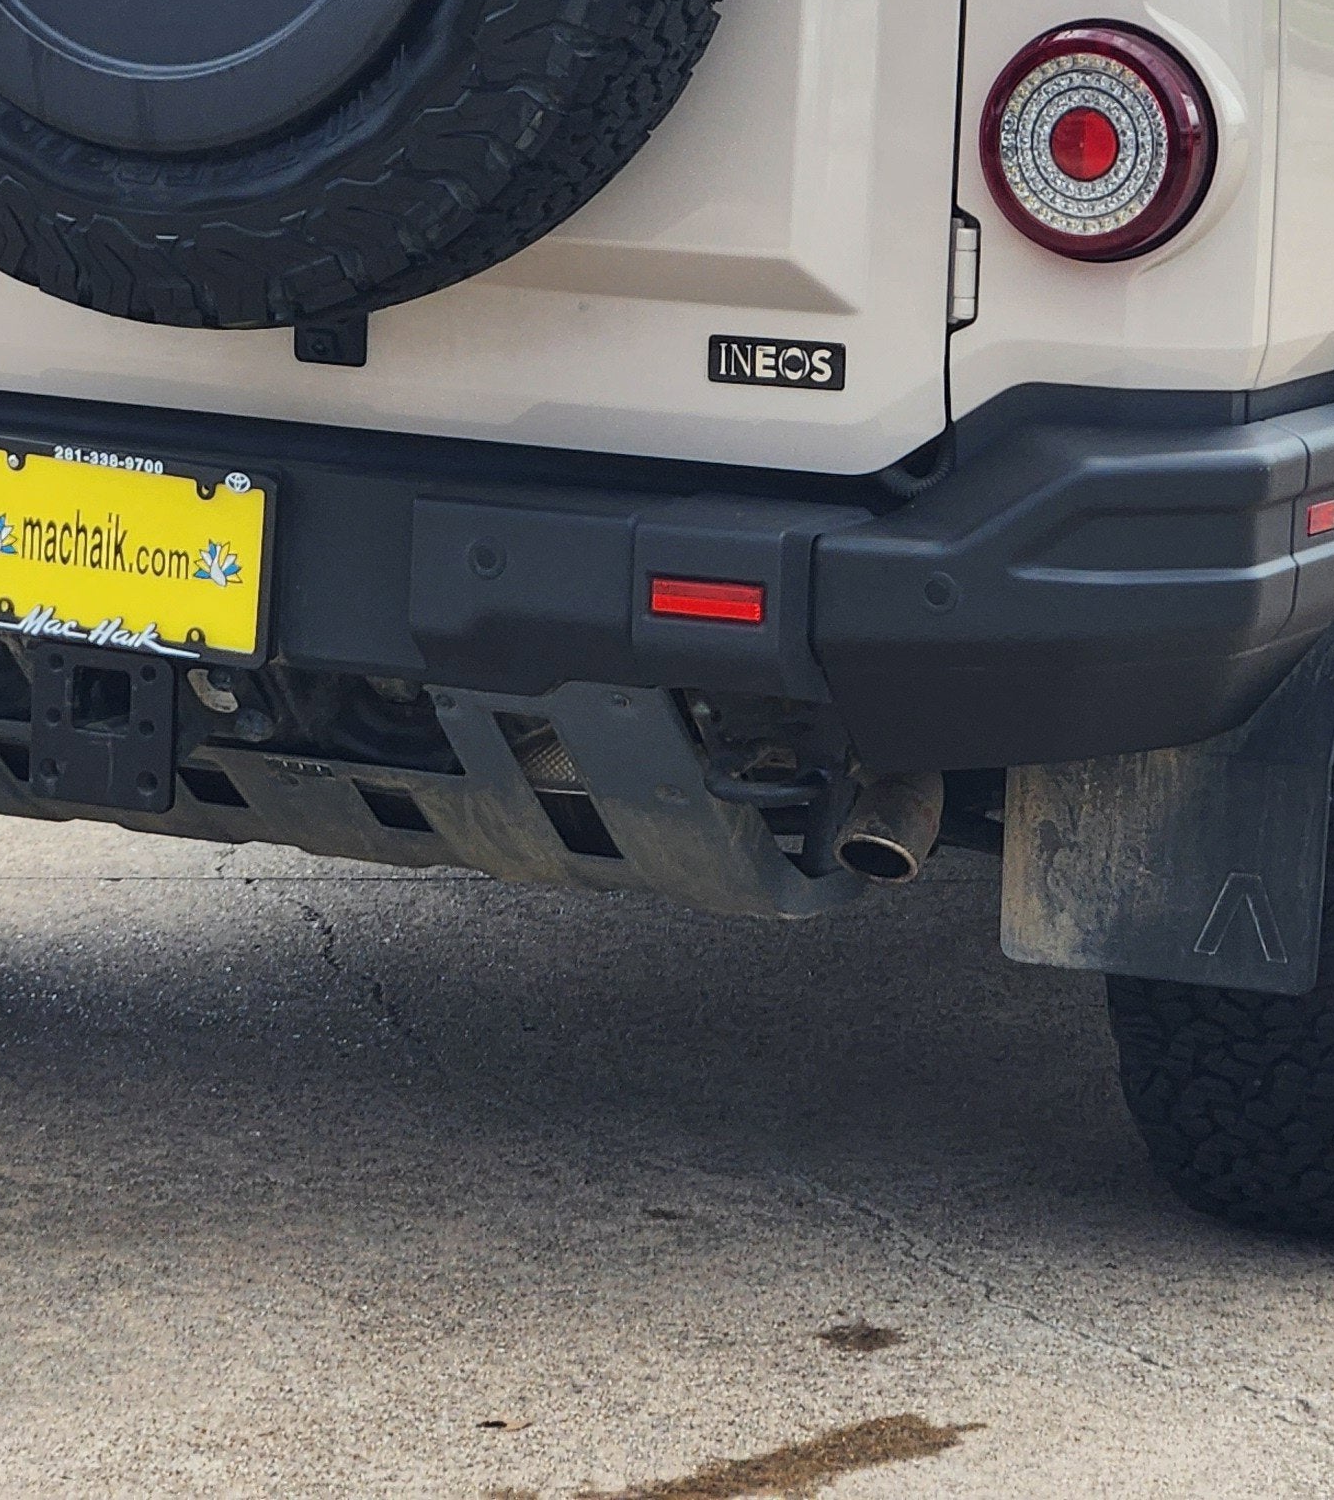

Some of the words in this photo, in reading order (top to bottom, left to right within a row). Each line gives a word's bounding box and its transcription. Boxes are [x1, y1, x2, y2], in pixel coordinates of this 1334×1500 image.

[719, 342, 833, 383] INEOS
[20, 509, 190, 580] machaik.com
[10, 604, 87, 638] Mac
[86, 616, 185, 655] Haik
